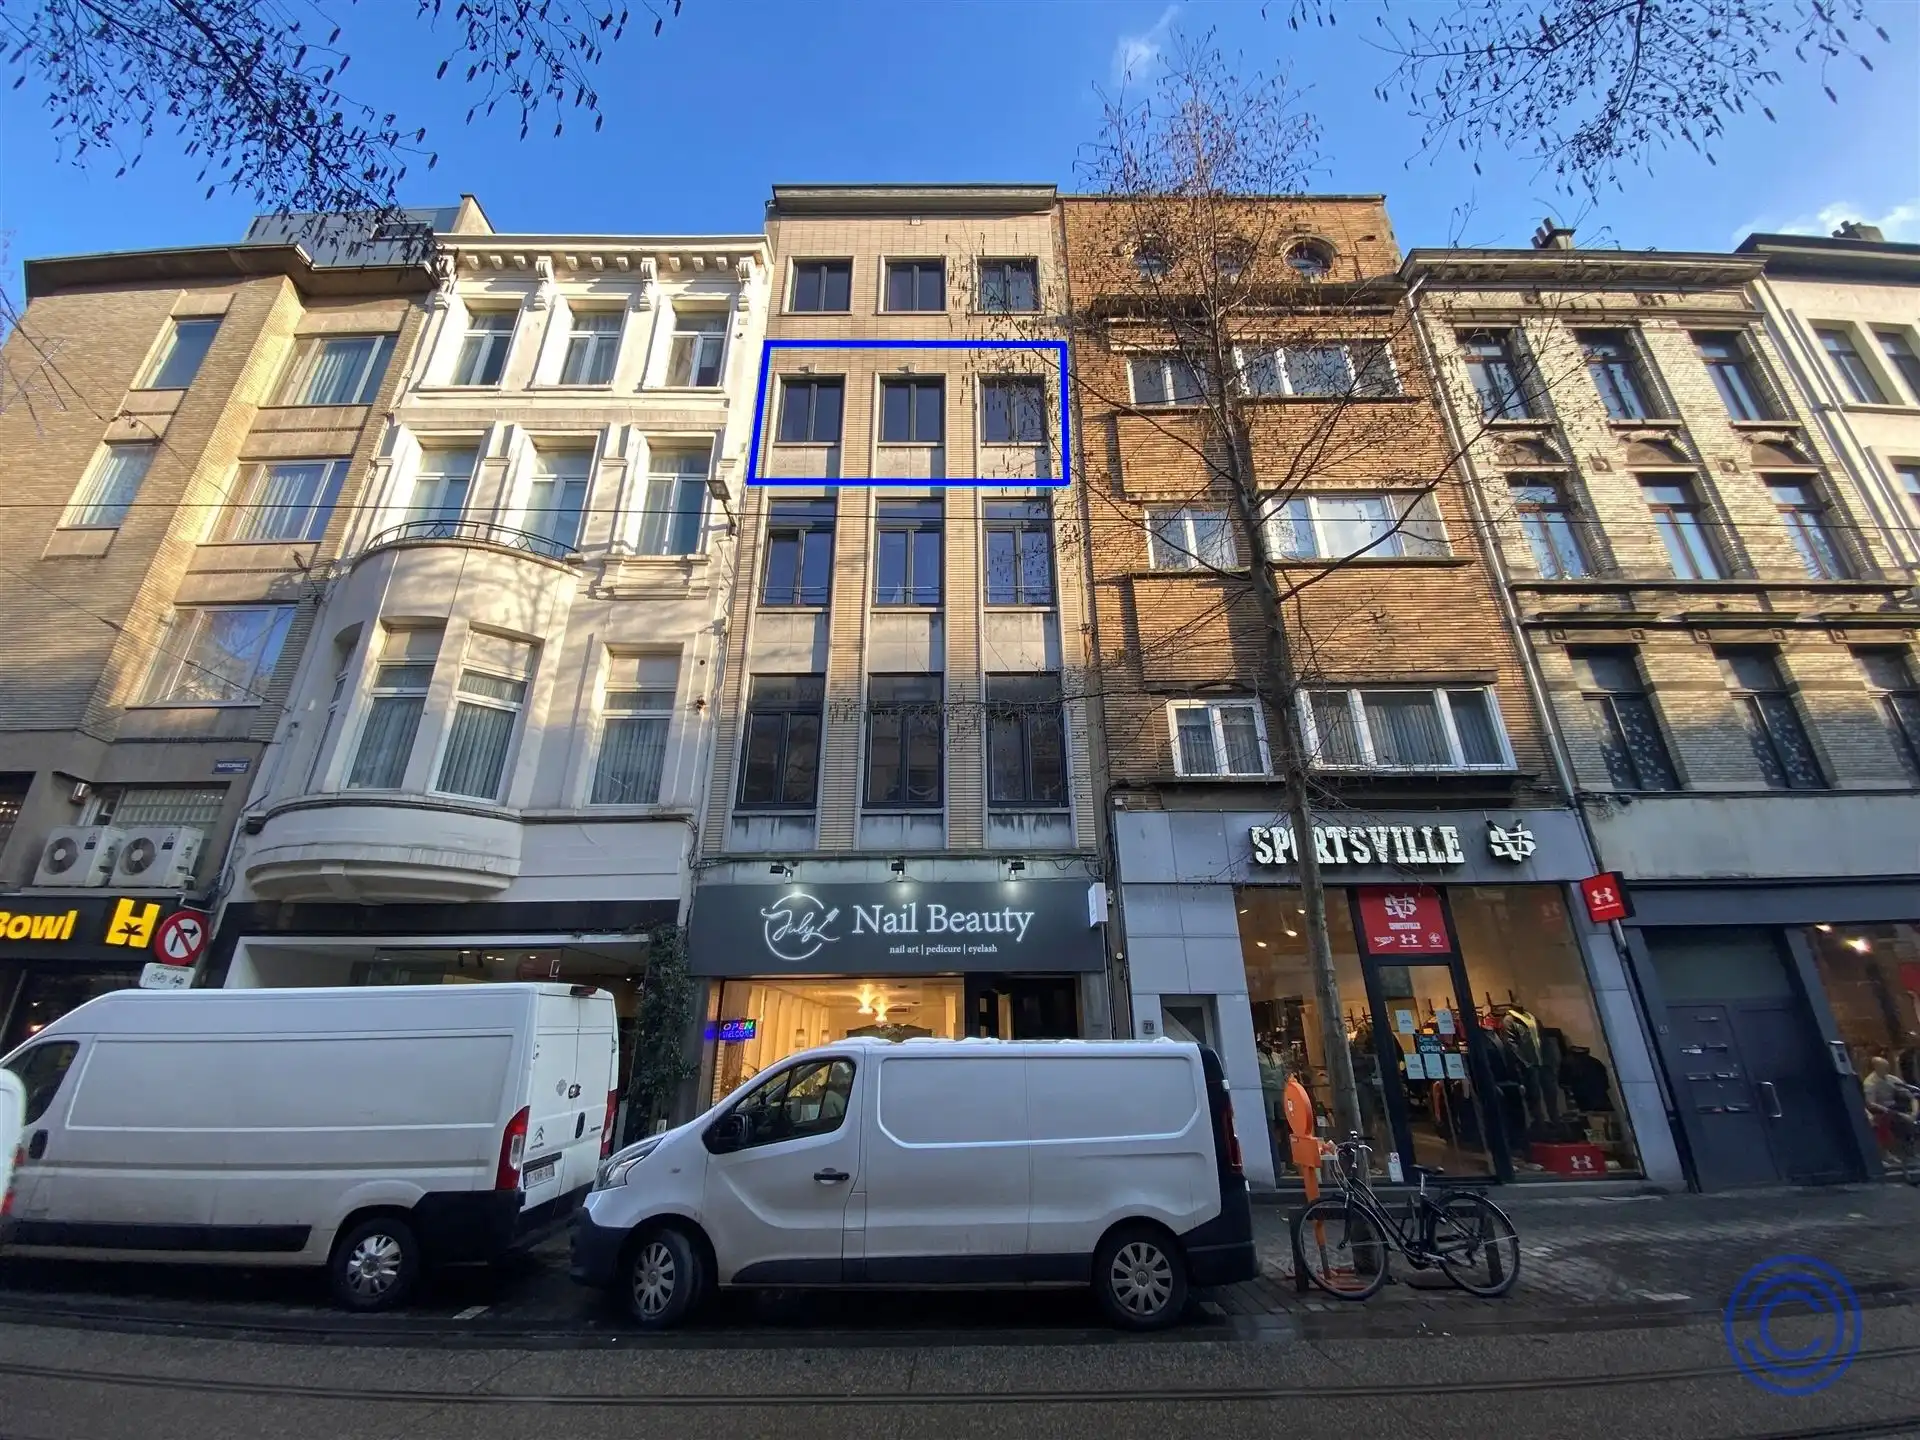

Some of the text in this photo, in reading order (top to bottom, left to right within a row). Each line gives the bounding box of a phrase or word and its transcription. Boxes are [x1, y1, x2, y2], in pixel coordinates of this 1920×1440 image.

[1250, 826, 1465, 863] SPRTSVILLE
[852, 902, 1035, 943] Nail Beauty
[889, 944, 998, 956] nail art pedicure eyelash
[723, 1021, 754, 1031] OPEN
